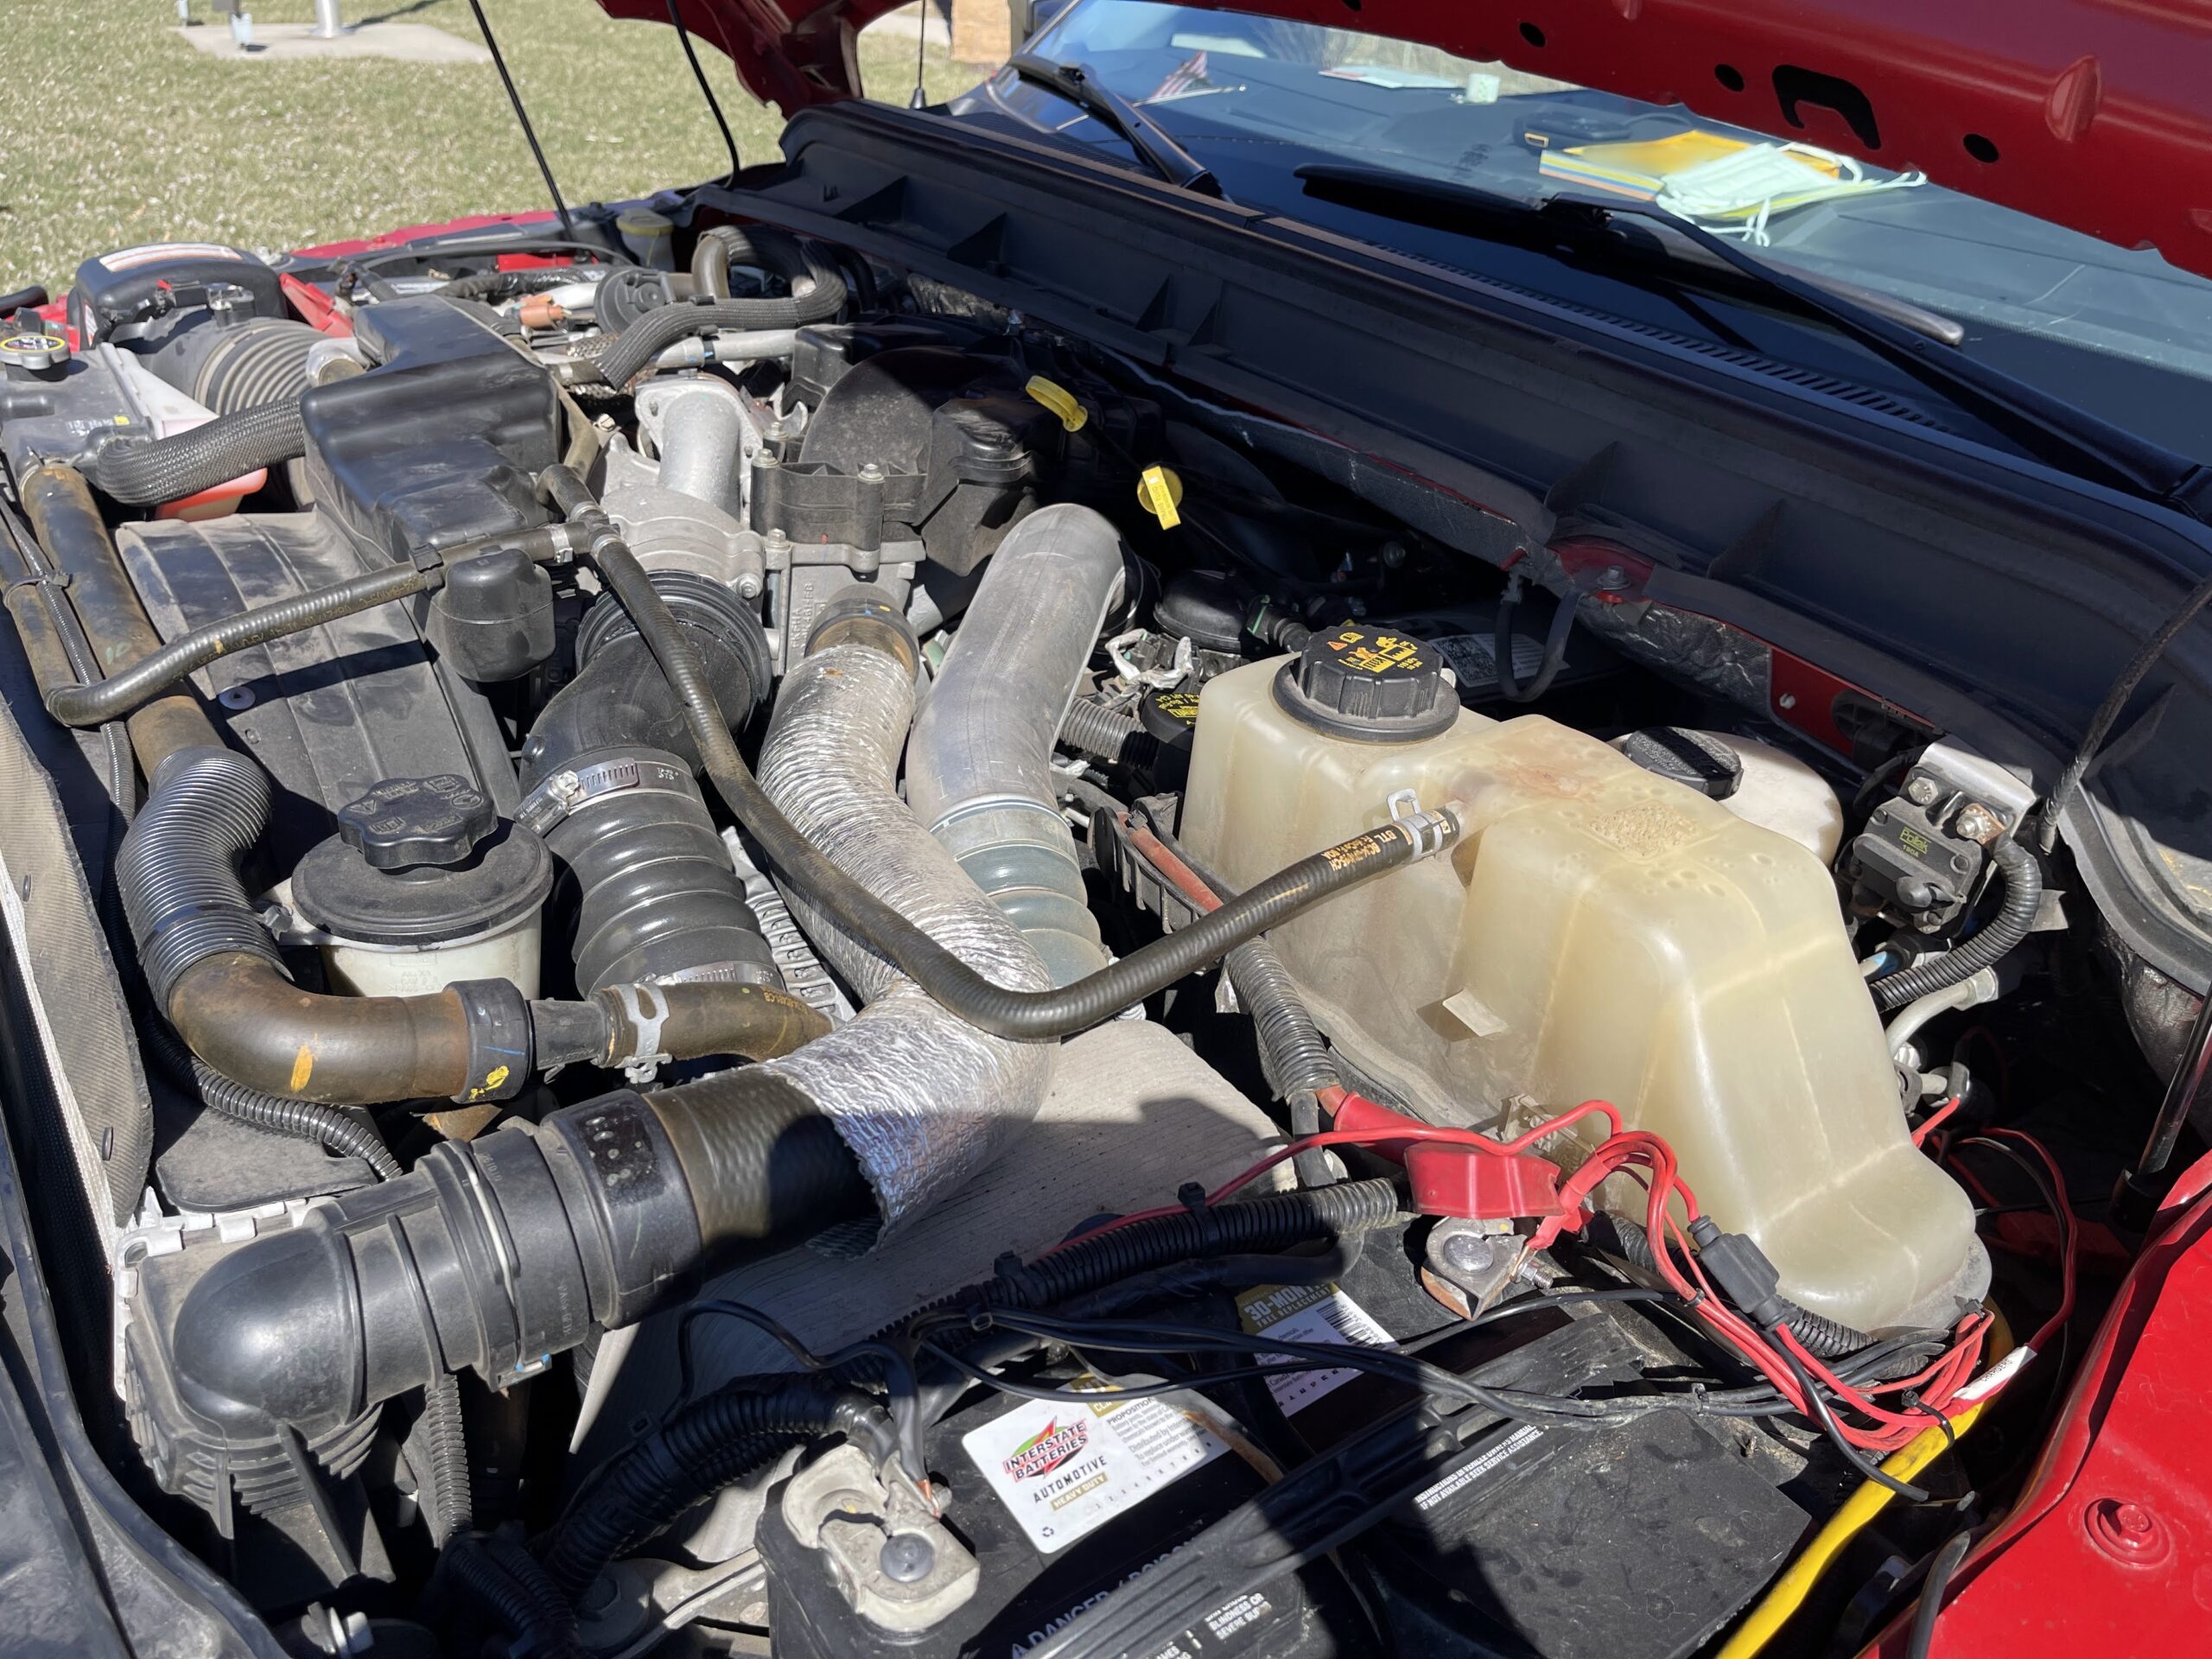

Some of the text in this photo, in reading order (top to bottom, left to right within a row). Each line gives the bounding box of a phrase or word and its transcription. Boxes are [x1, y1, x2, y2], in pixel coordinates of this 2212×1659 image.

[1900, 828, 1929, 853] Pollak
[1244, 1284, 1325, 1321] 30-MON
[1256, 1314, 1278, 1327] FREE
[1277, 1286, 1331, 1316] REPLACEMENT
[1005, 1422, 1085, 1471] INTERSTATE
[1015, 1434, 1087, 1479] BATTERIES
[1033, 1455, 1108, 1503] AUTOMOTIVE
[1053, 1475, 1105, 1510] HEAVY DUTY
[1427, 1494, 1442, 1506] NOT
[1441, 1475, 1473, 1497] AVAILABLE
[1470, 1466, 1488, 1479] SEEK
[1484, 1451, 1510, 1469] SERVICE
[1209, 1600, 1251, 1631] BLINDNESS
[1249, 1593, 1264, 1605] OR
[1216, 1617, 1247, 1640] SEVERE
